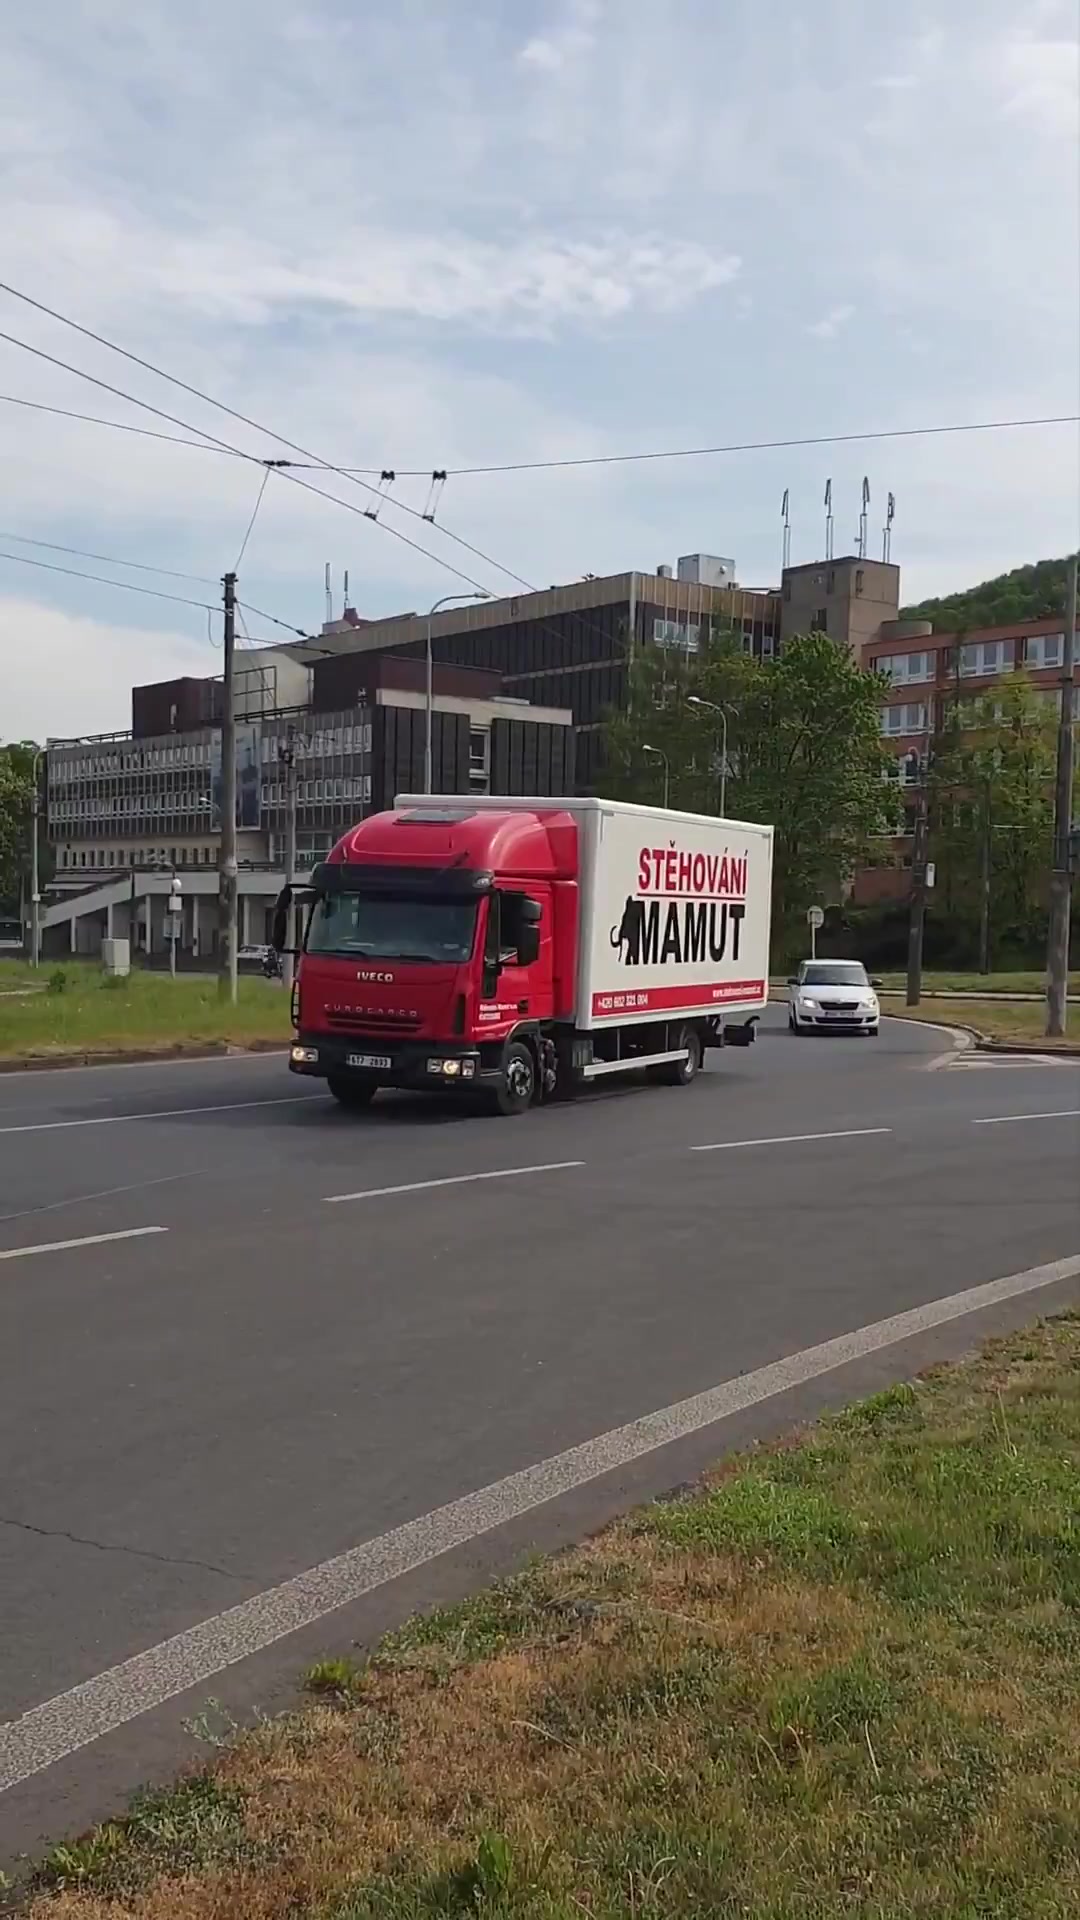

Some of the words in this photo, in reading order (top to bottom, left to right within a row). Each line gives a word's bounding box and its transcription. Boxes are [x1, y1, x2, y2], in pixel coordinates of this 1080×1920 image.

[638, 840, 748, 895] STĚHOVÁNÍ
[632, 900, 745, 965] MAMUT
[356, 971, 394, 982] IVECO
[324, 1003, 418, 1018] EUROCARGO
